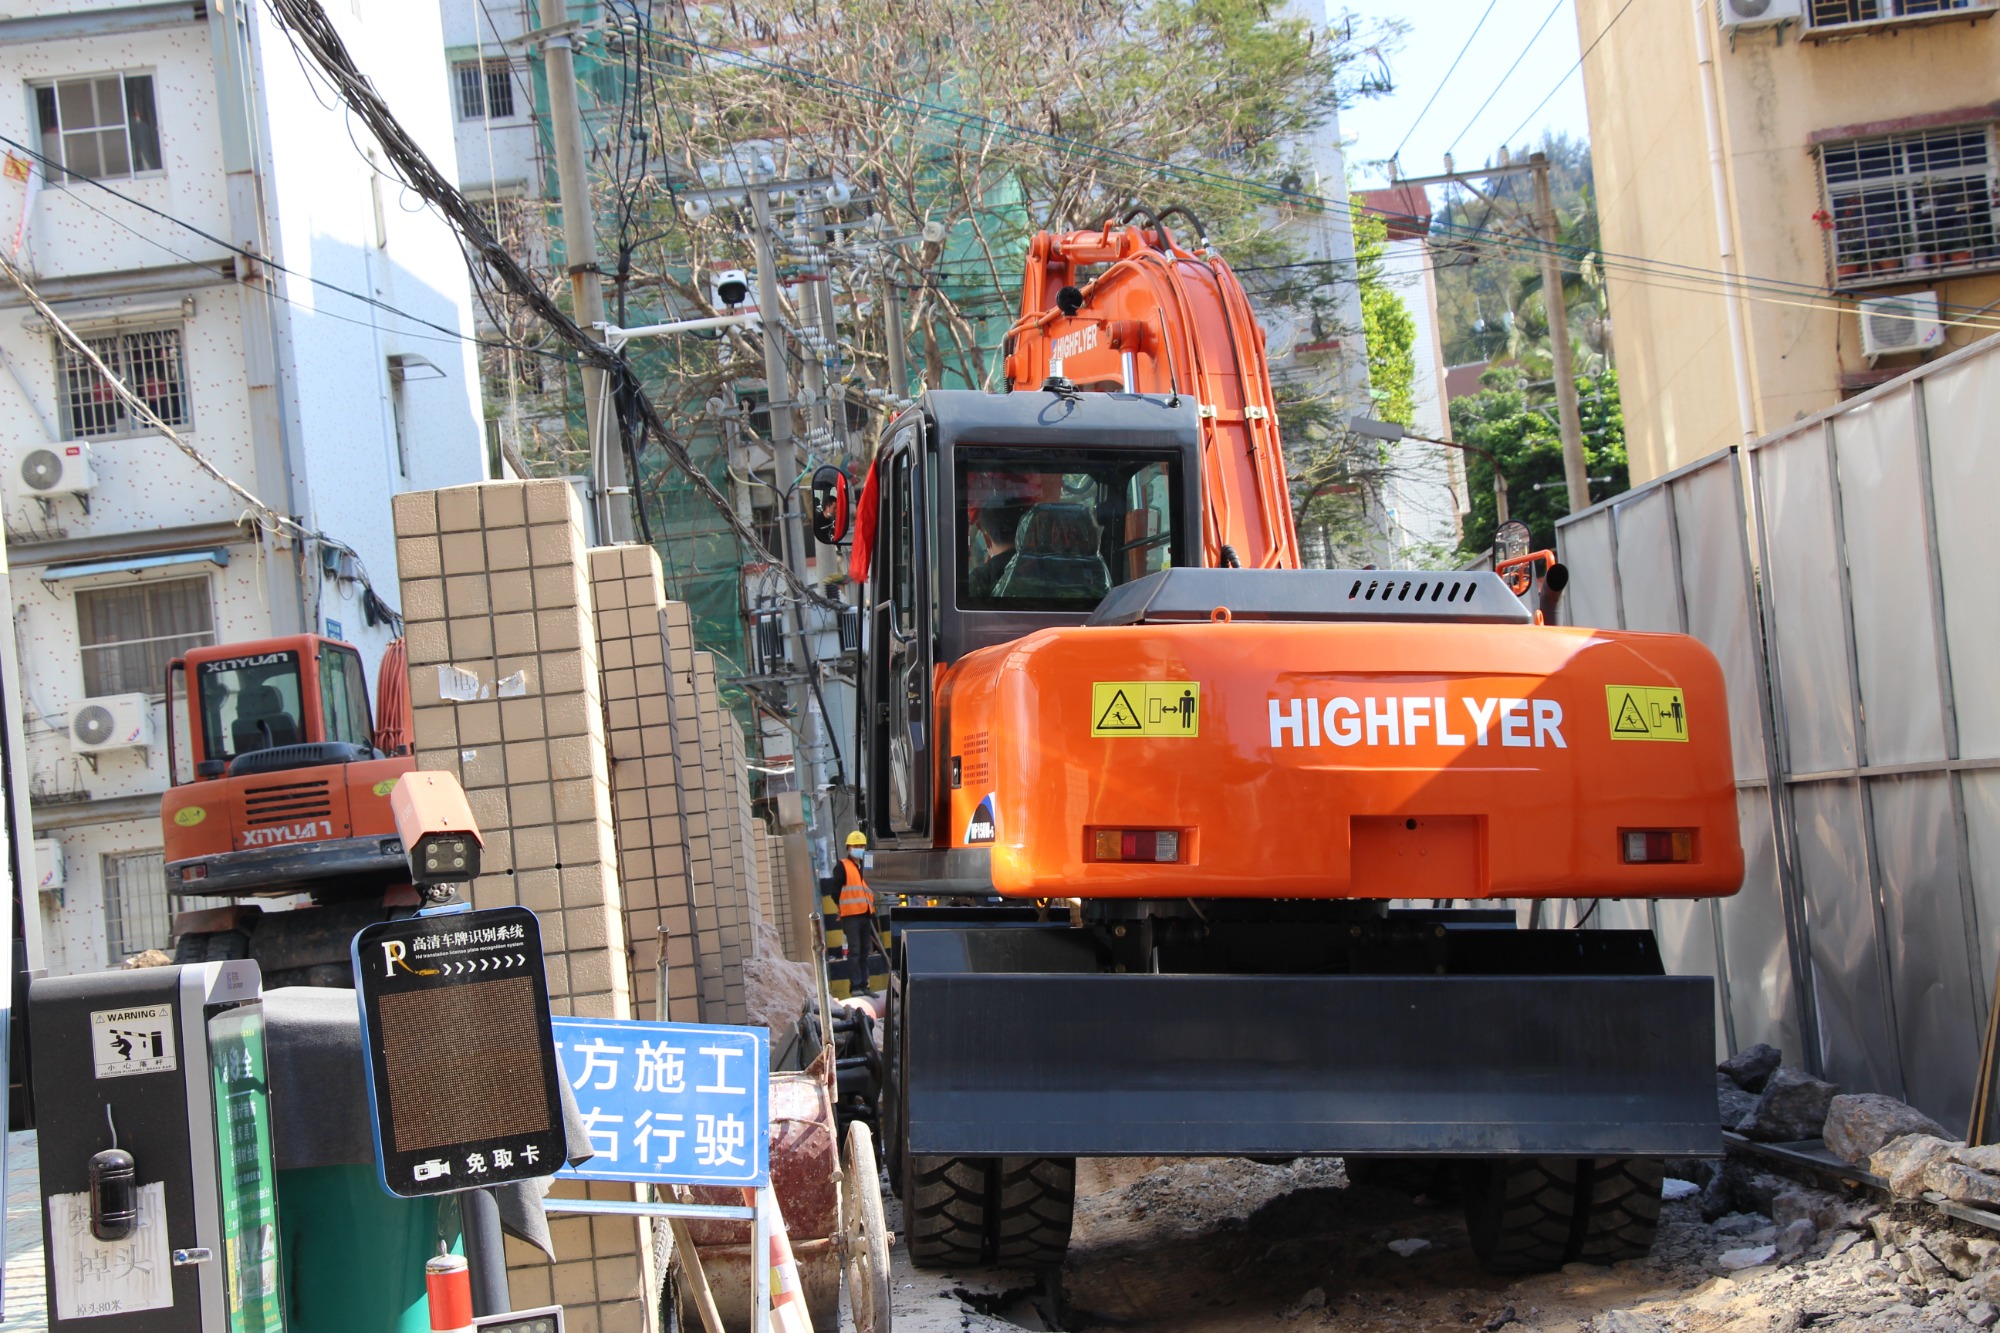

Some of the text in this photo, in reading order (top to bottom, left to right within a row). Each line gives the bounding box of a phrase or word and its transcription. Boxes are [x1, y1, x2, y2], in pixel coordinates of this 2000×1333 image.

[1057, 323, 1098, 359] HIGHFLYER
[1268, 696, 1568, 748] HIGHFLYER
[412, 923, 525, 952] 高清车牌识别系统
[479, 944, 507, 952] recognition
[507, 941, 524, 949] system
[107, 1009, 156, 1022] WARNING
[107, 1058, 164, 1071] 小心落杆
[554, 1037, 747, 1095] 方施工
[581, 1106, 747, 1167] 右行驶
[466, 1144, 541, 1175] 免取卡
[73, 1243, 154, 1285] 掉头
[75, 1299, 123, 1317] 掉头80米
